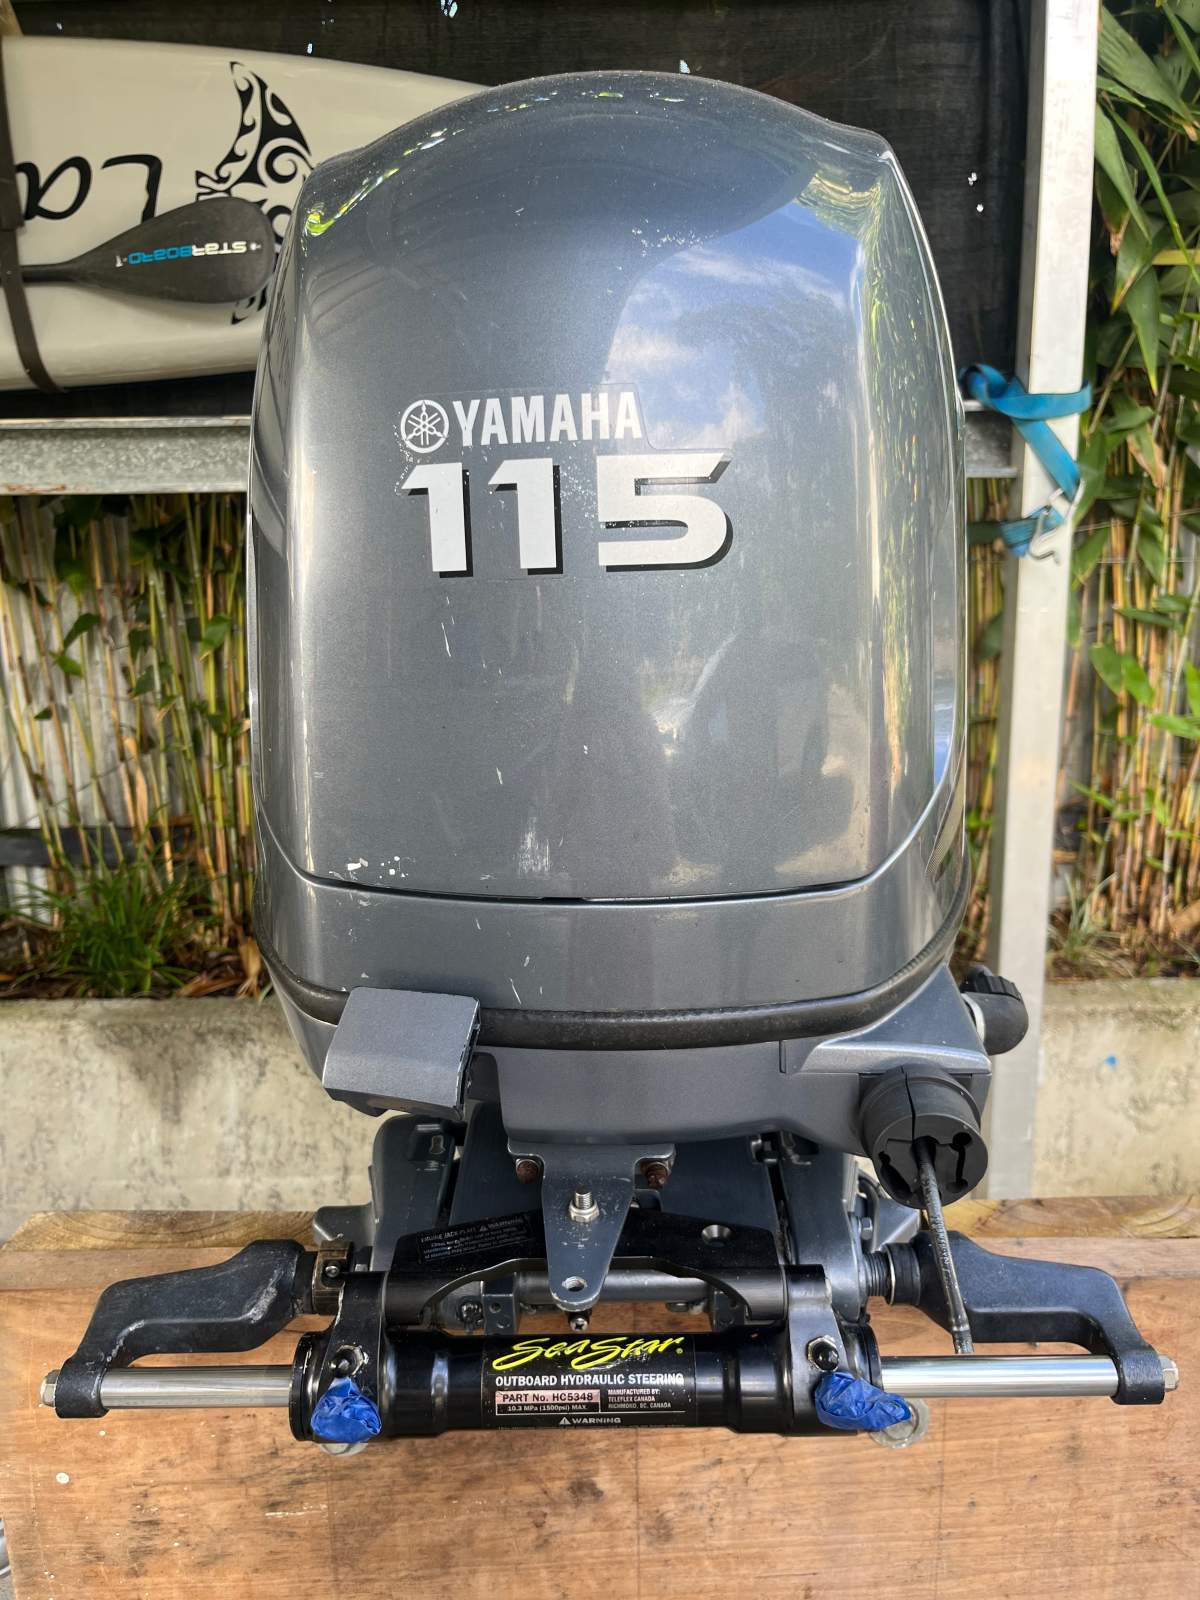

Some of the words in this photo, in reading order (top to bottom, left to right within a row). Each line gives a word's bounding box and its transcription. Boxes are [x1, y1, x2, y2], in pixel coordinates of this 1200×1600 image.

[452, 391, 643, 447] YAMAHA
[401, 452, 734, 578] 115
[492, 1336, 685, 1371] SeaStar
[495, 1375, 558, 1387] OUTBOARD
[560, 1374, 625, 1386] HYDRAULIC
[628, 1373, 685, 1385] STEERING
[502, 1393, 529, 1402] PART
[532, 1393, 549, 1402] No.
[552, 1392, 594, 1402] HC5348
[539, 1404, 570, 1412] (1500psi)
